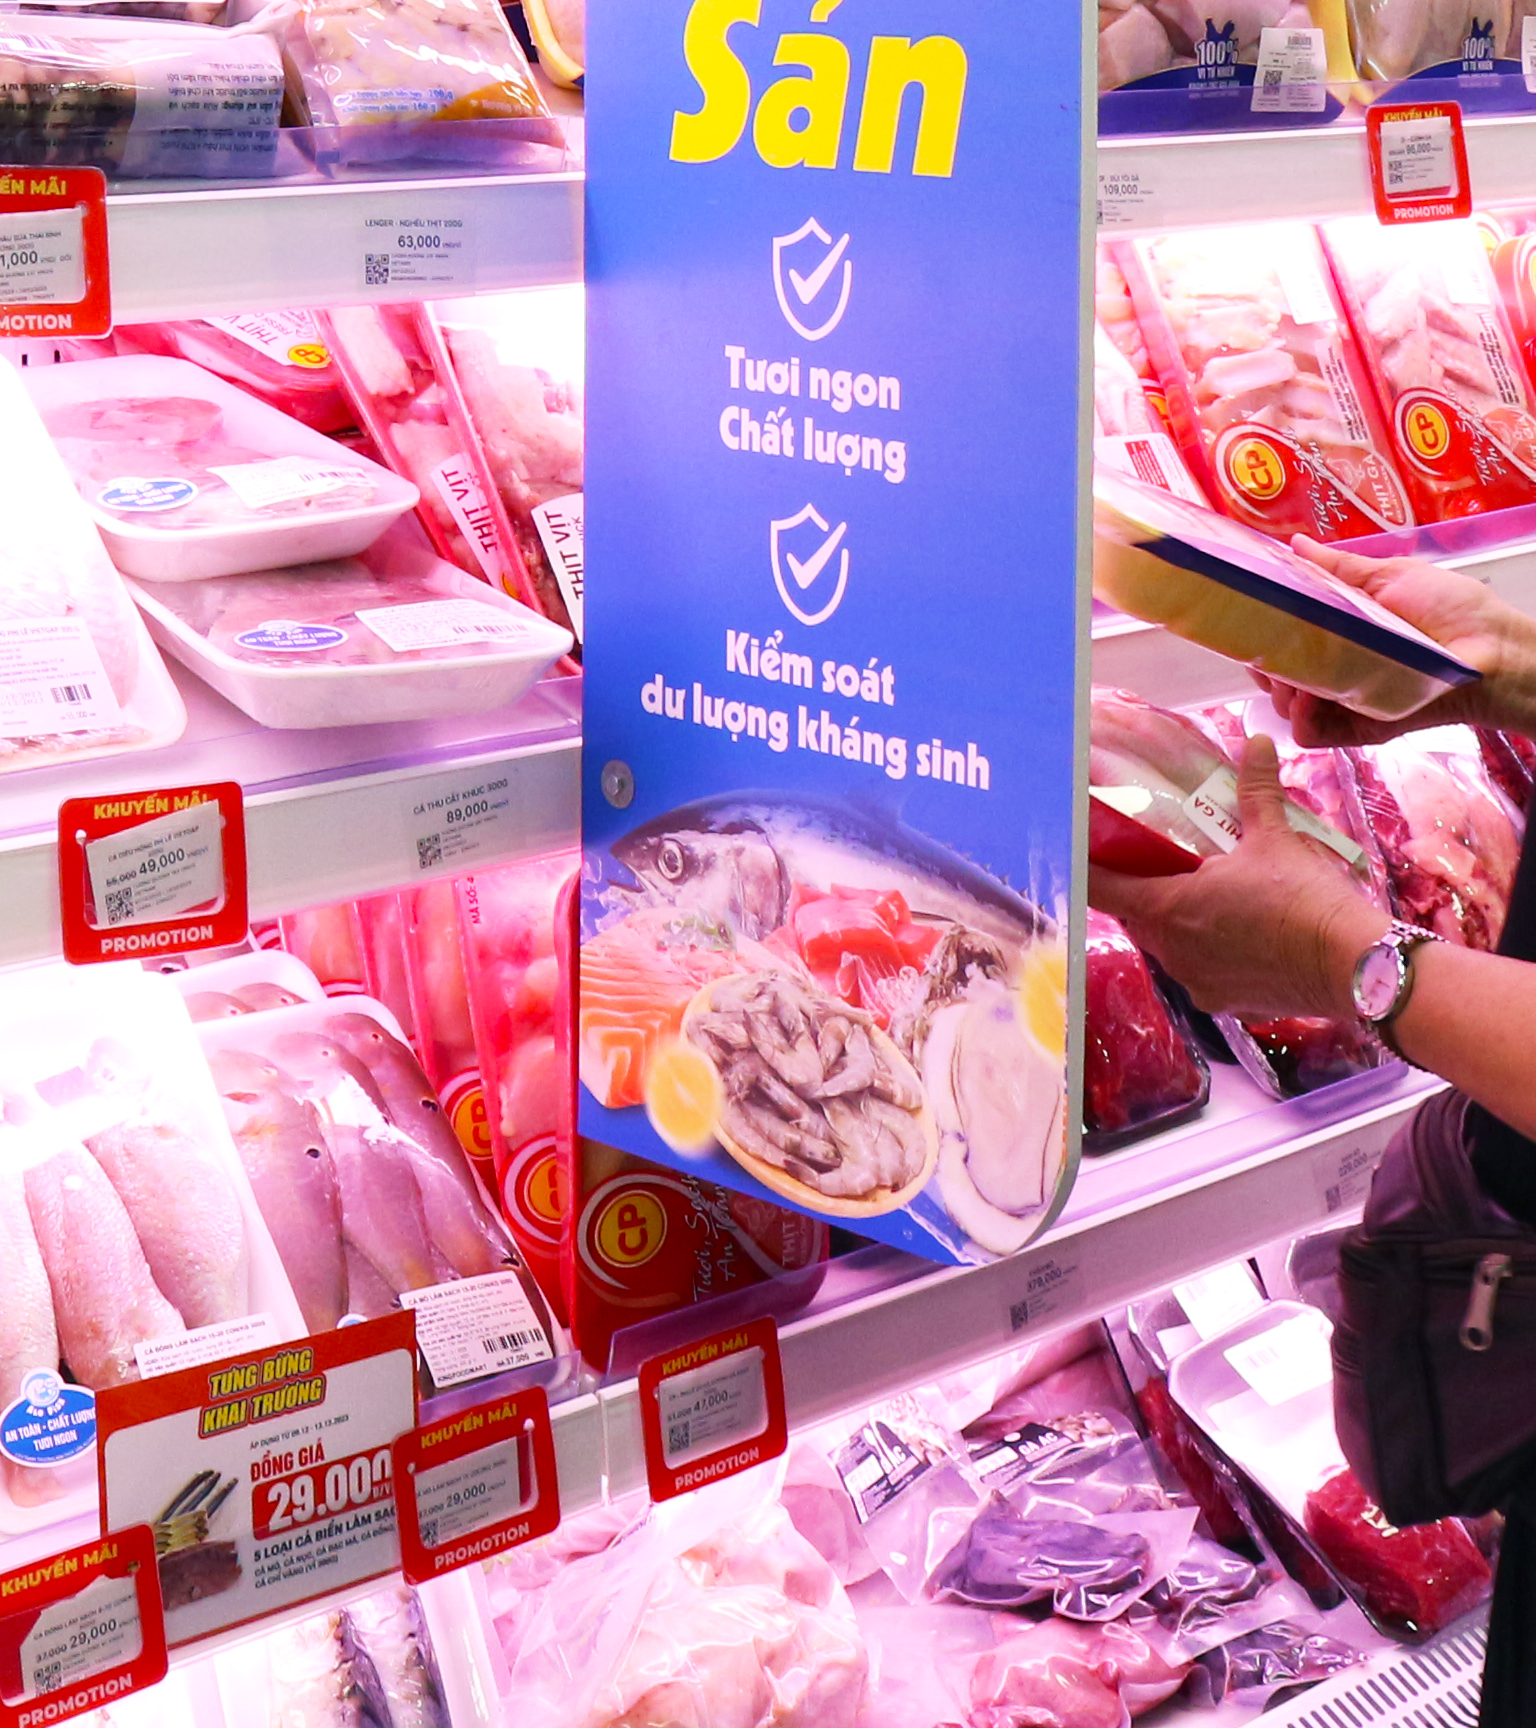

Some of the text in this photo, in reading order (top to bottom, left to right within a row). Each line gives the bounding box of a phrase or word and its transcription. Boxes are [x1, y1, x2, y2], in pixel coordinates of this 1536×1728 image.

[29, 175, 68, 196] MÃI
[1393, 203, 1455, 221] PROMOTION
[397, 234, 442, 252] 63,000
[723, 345, 901, 412] Tươi ngon
[718, 406, 907, 484] Chất lượng
[1414, 412, 1438, 450] CP
[1245, 447, 1274, 492] CP
[724, 629, 896, 708] Kiểm soát
[640, 674, 991, 792] dư lượng kháng sinh
[93, 792, 170, 821] KHUYẾN
[446, 799, 489, 824] 89,000
[138, 847, 185, 876] 49,000
[99, 924, 215, 955] PROMOTION
[616, 1202, 649, 1256] CP
[661, 1332, 749, 1376] KHUYẾN MÃI
[201, 1377, 326, 1437] KHAI TRƯƠNG
[693, 1389, 729, 1413] 47,000
[4, 1429, 18, 1444] AN
[18, 1423, 42, 1441] TOÀN
[47, 1413, 70, 1433] CHẤT
[32, 1430, 78, 1452] TƯƠI NGON
[420, 1401, 518, 1450] KHUYẾN MÃI
[250, 1437, 326, 1483] ĐỒNG GIÁ
[674, 1446, 760, 1492] PROMOTION
[445, 1482, 487, 1508] 29,000
[253, 1512, 373, 1563] 5 LOẠI CÁ BIỂN LÀM
[434, 1521, 531, 1571] PROMOTION
[0, 1542, 119, 1598] KHUYẾN MÃI
[69, 1618, 118, 1650] 29,000
[17, 1672, 134, 1728] PROMOTION
